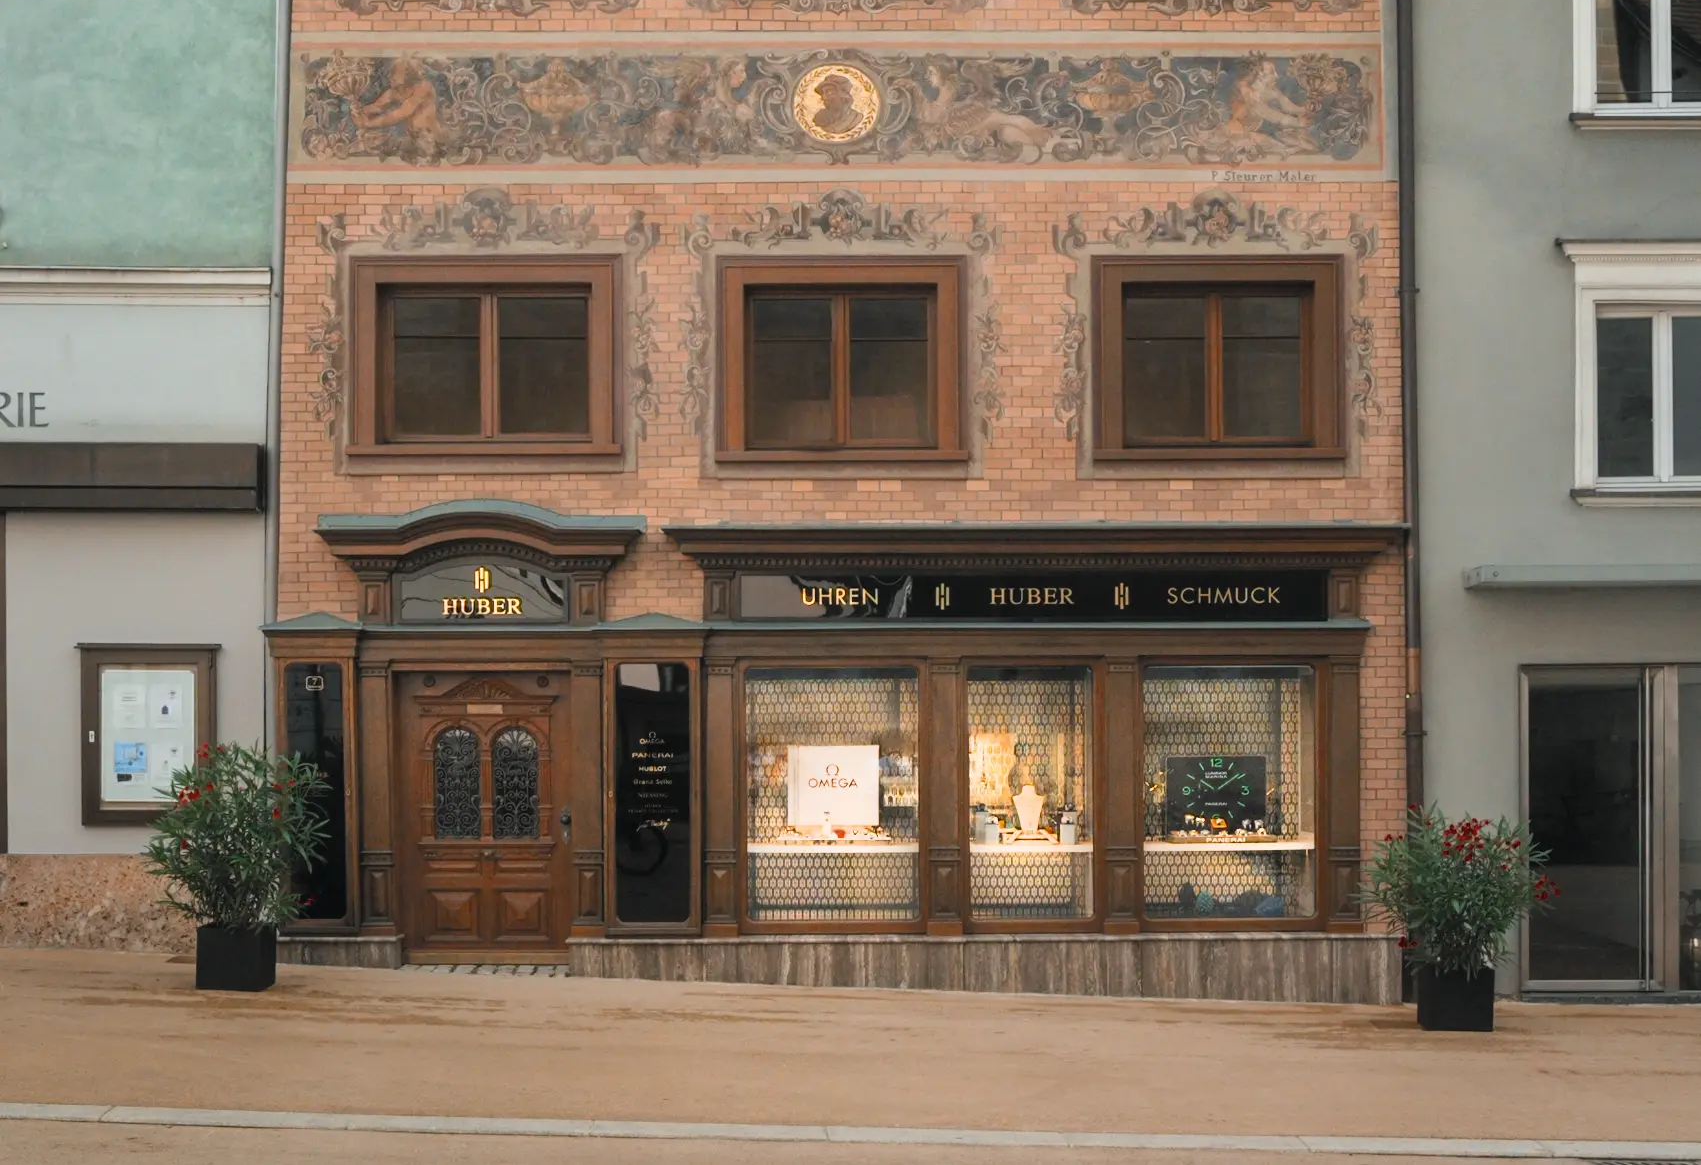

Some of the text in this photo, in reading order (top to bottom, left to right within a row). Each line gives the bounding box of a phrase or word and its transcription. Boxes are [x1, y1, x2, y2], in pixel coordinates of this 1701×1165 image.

[802, 587, 1280, 606] UHREN HUBER SCHMUCK
[442, 597, 522, 616] HUBER
[311, 677, 318, 685] 7
[1210, 758, 1223, 768] 12
[808, 777, 858, 789] OMEGA
[1241, 785, 1250, 795] 3
